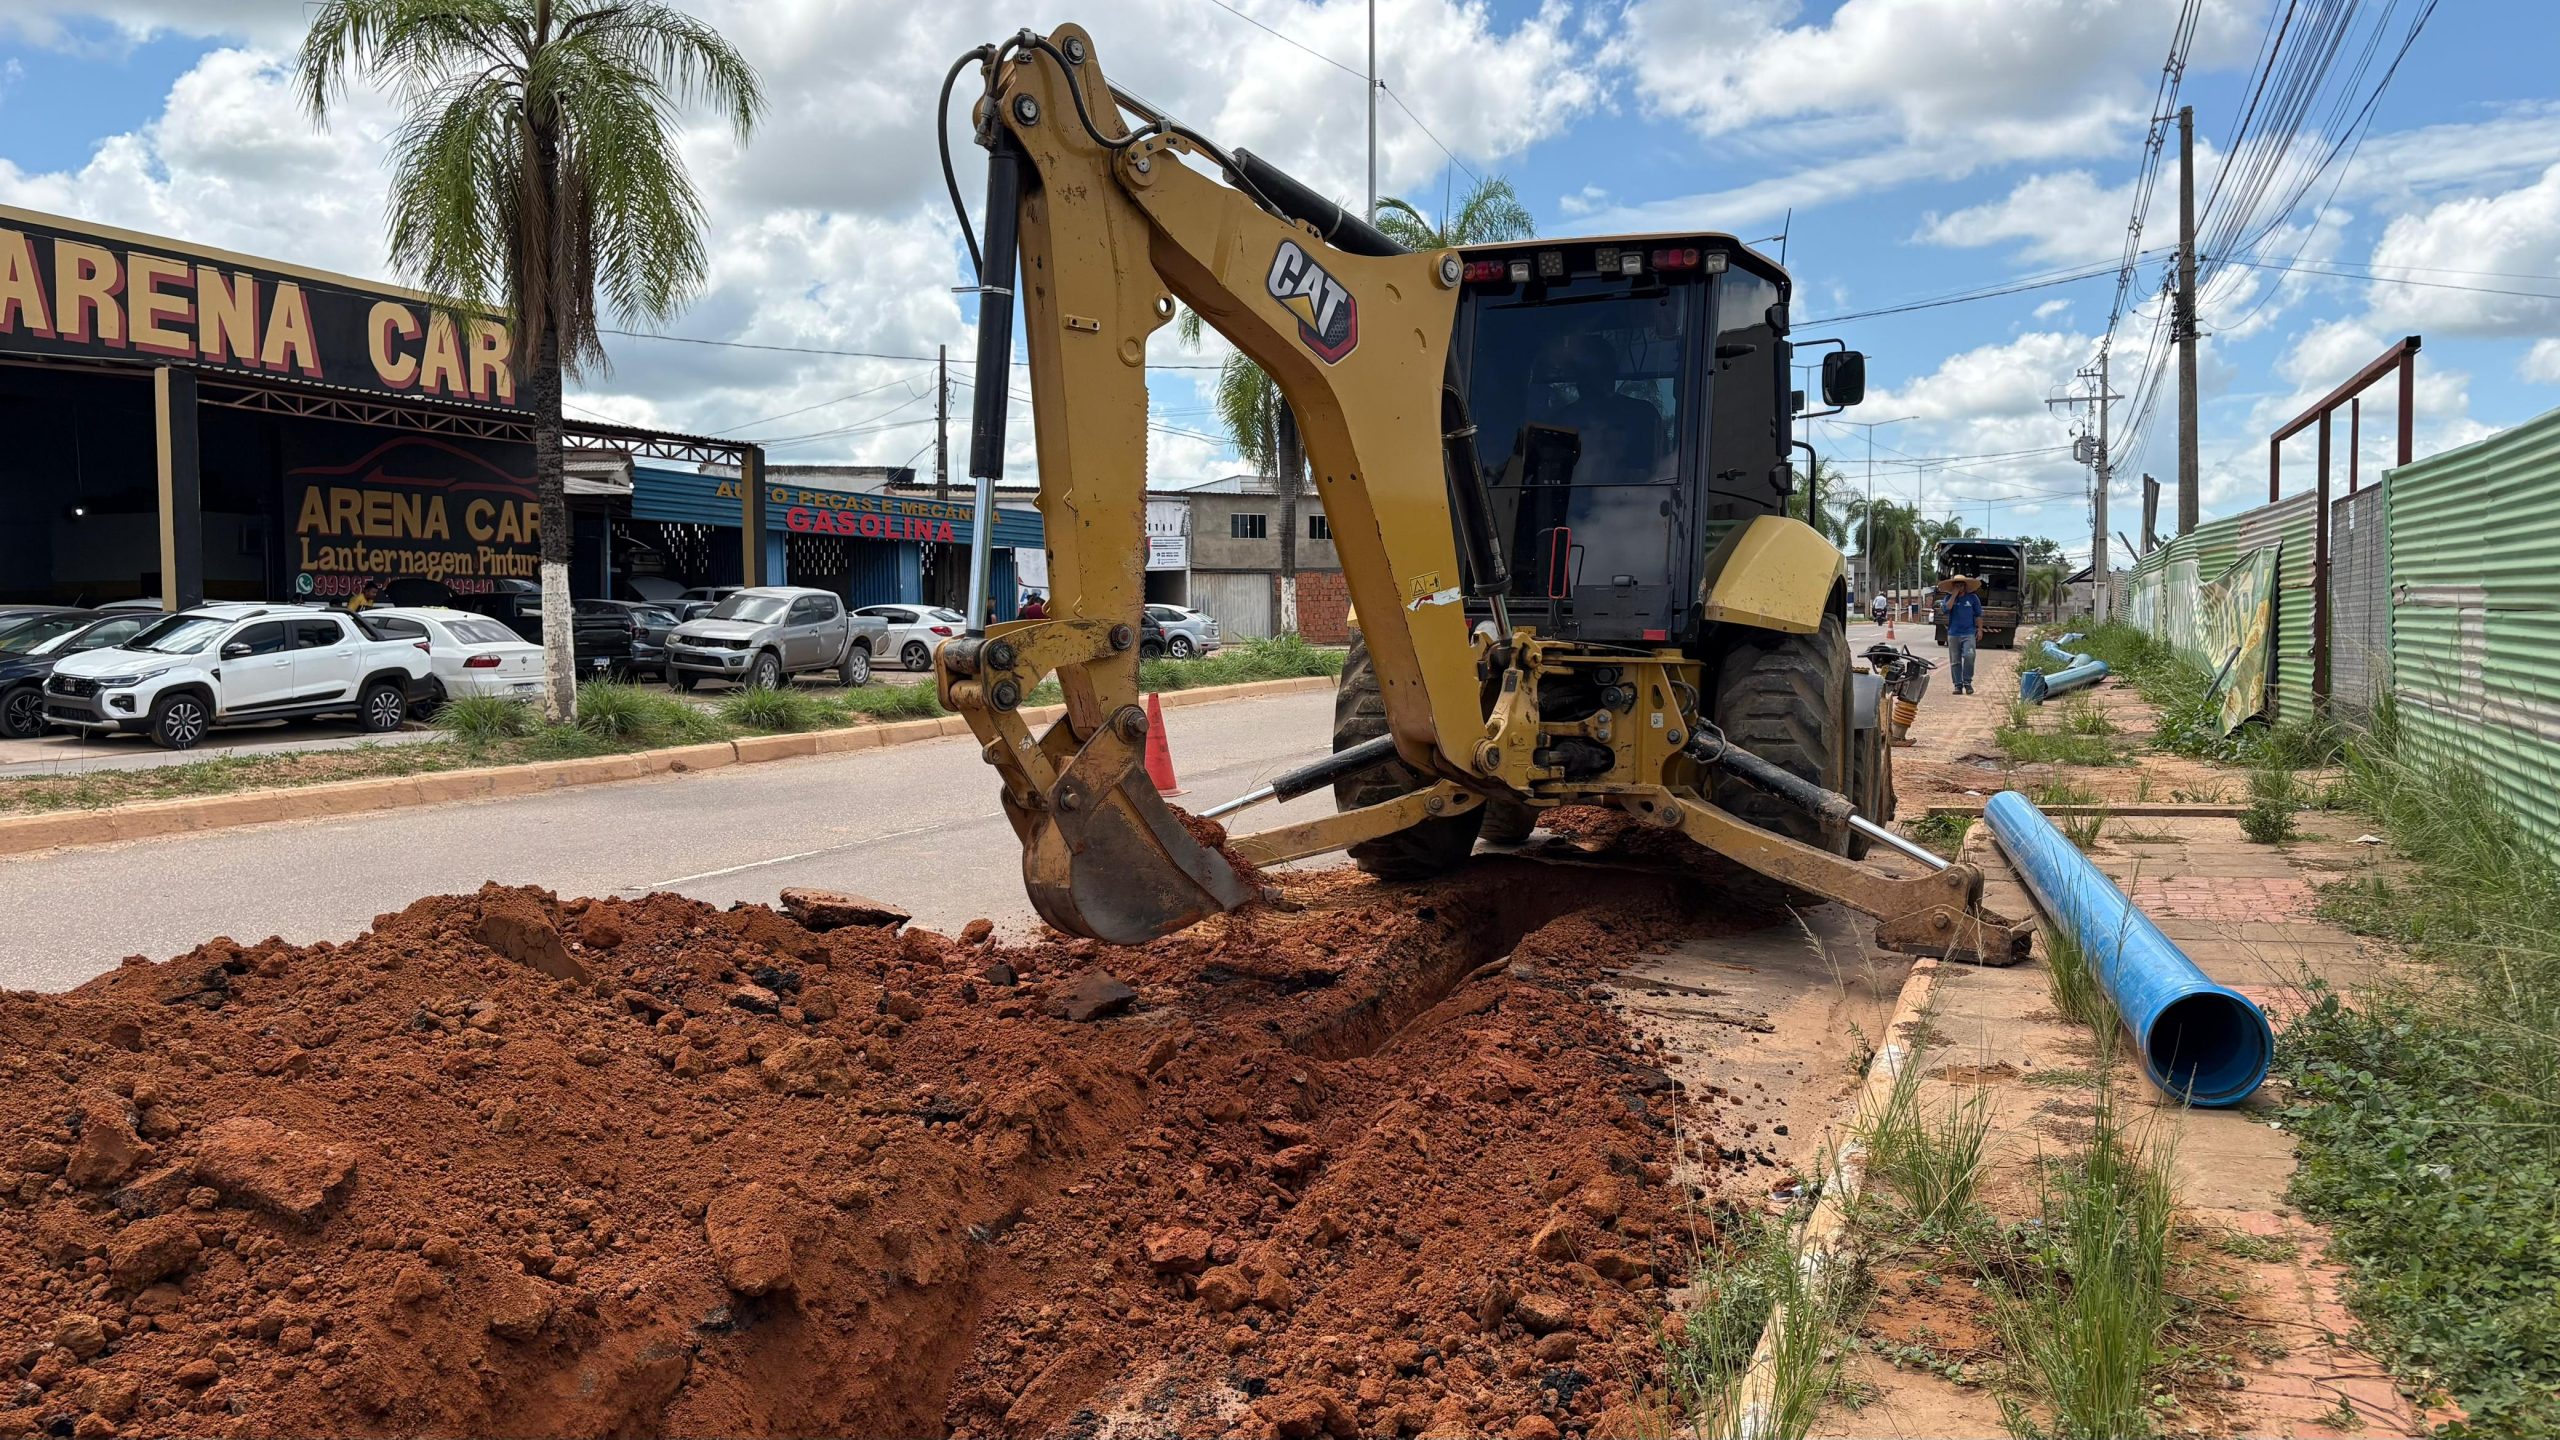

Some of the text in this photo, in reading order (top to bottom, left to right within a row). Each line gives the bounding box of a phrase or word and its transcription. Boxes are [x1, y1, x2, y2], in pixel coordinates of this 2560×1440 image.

[0, 228, 515, 405] ARENA CAR
[1268, 241, 1347, 337] CAT
[296, 486, 542, 544] ARENA CAR
[786, 507, 954, 542] GASOLINA
[799, 491, 873, 512] PEÇAS
[882, 500, 893, 513] E
